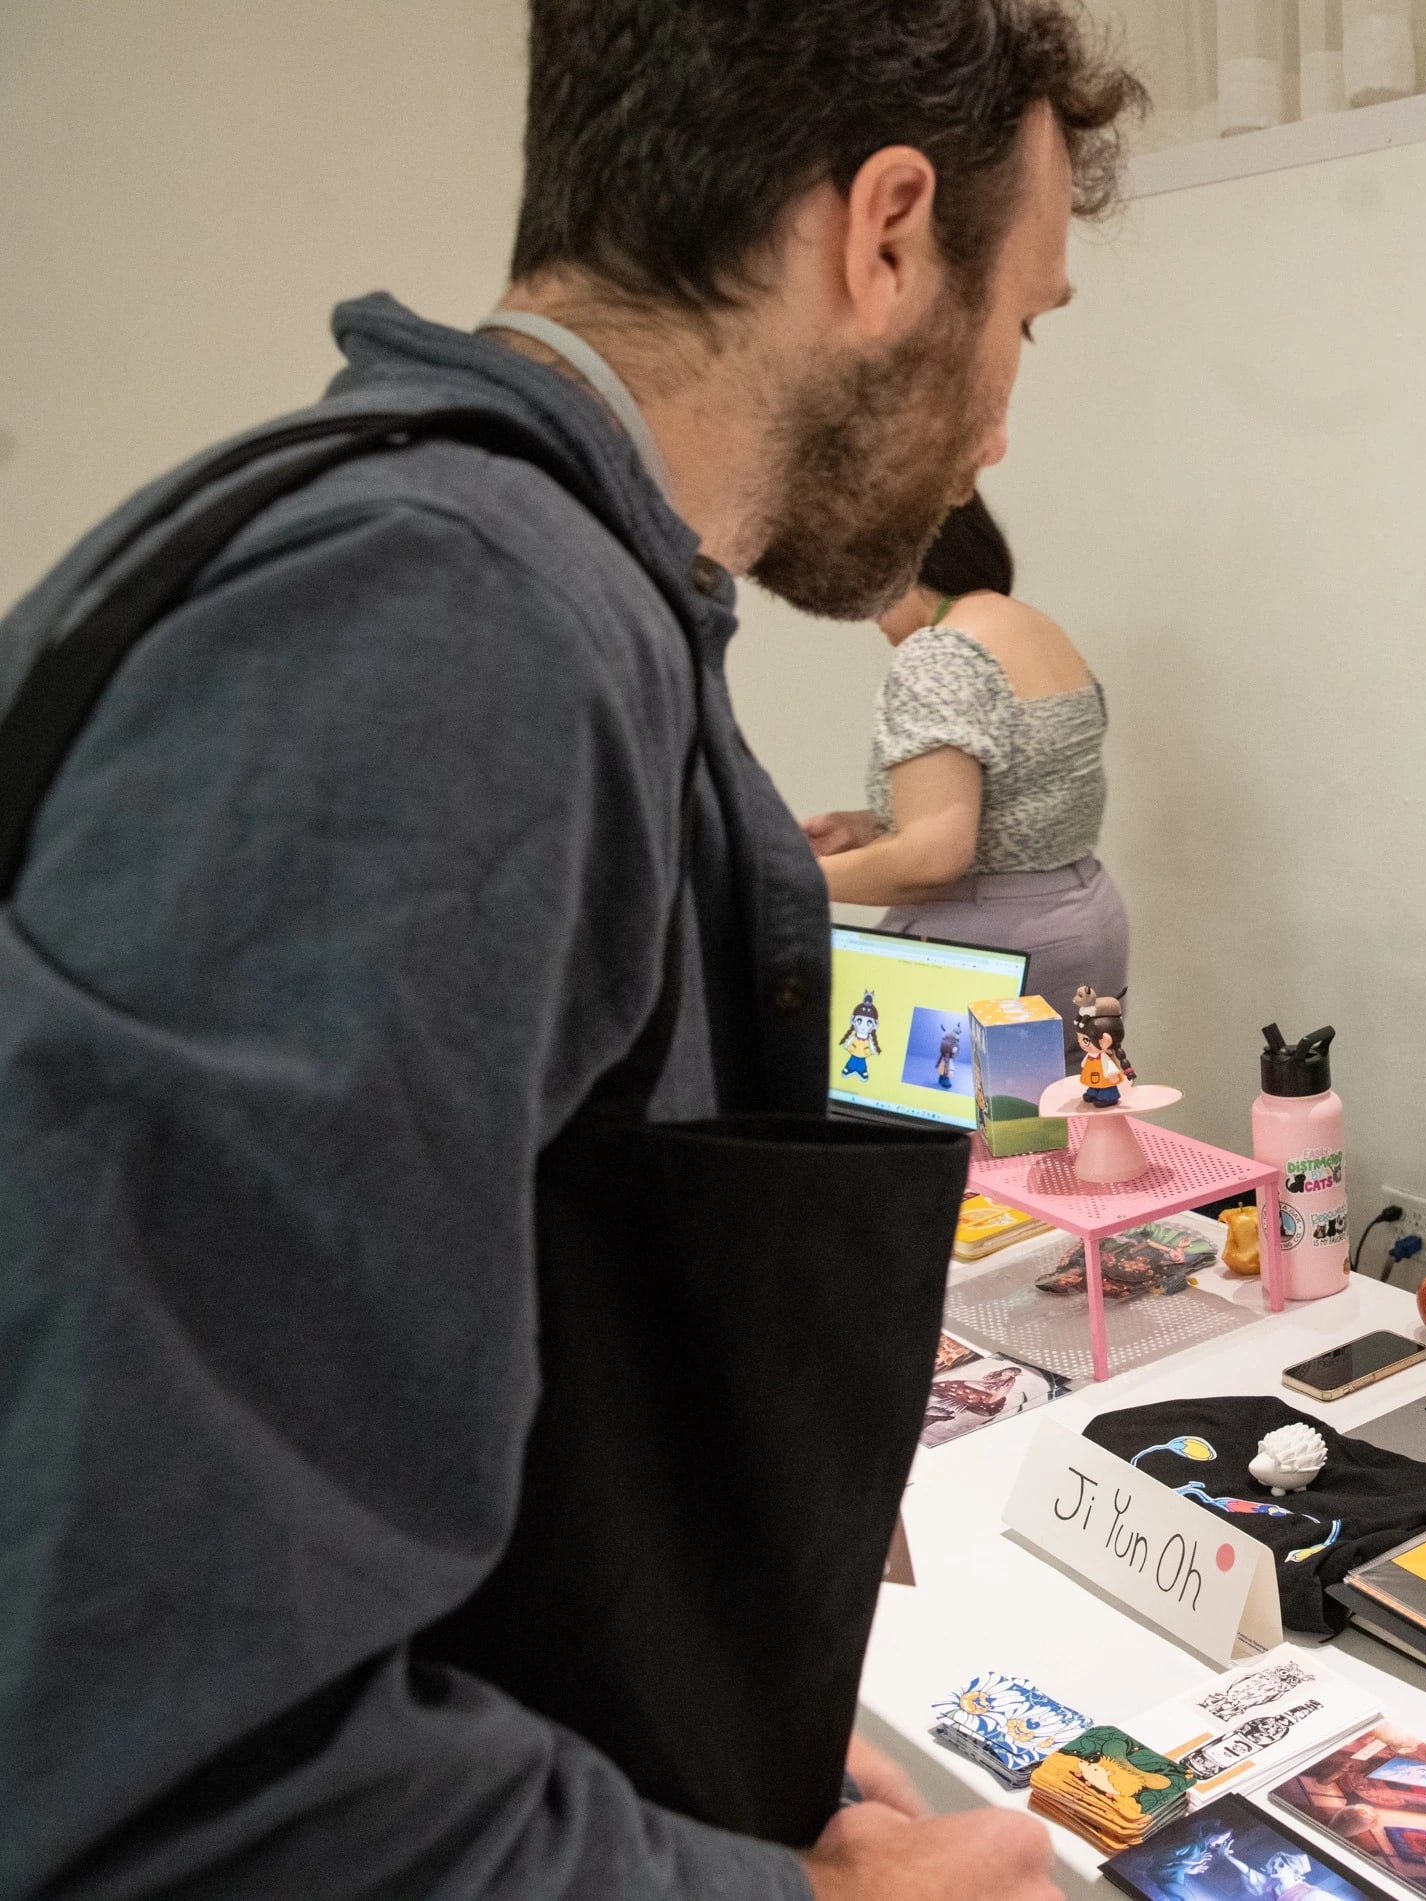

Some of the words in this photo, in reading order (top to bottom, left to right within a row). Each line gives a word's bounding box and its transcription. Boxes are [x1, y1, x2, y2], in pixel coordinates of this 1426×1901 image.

[1304, 1176, 1333, 1192] CATS
[1054, 1467, 1098, 1530] Ji
[1105, 1488, 1148, 1573] Yun
[1156, 1533, 1202, 1612] Oh
